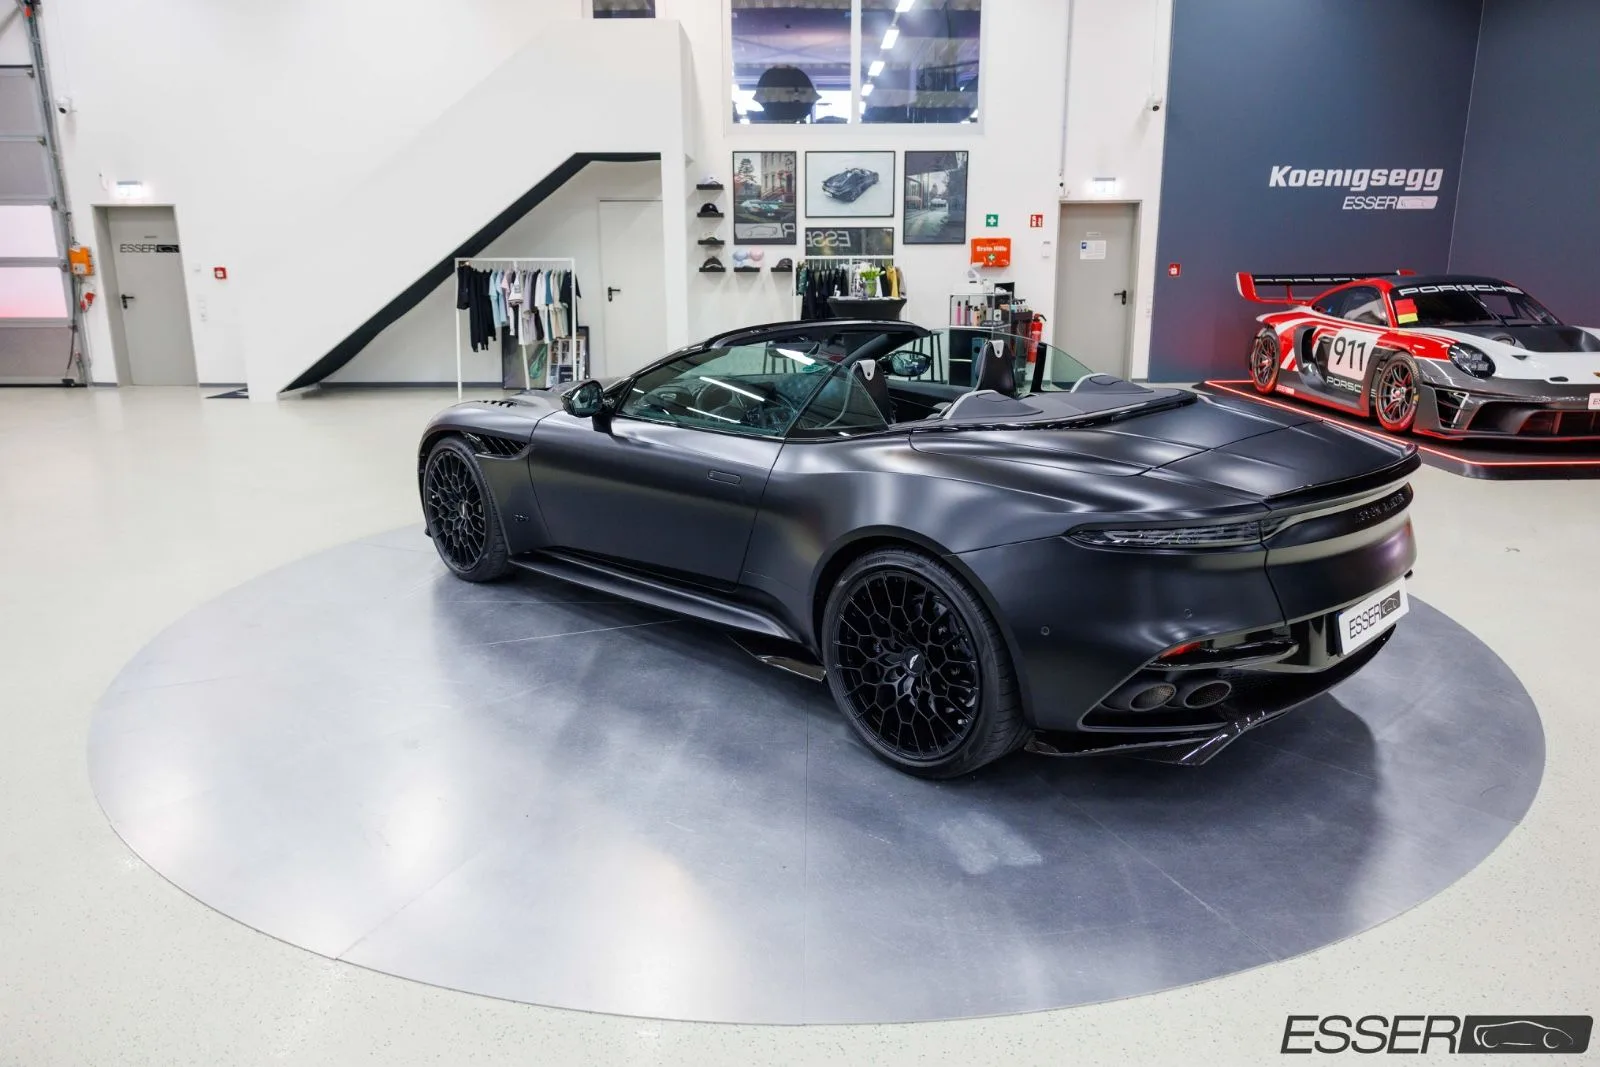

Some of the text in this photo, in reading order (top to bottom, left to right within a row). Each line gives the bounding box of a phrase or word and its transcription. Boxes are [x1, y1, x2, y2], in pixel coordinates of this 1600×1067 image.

[1269, 165, 1444, 191] Koenigsegg
[1342, 196, 1398, 210] ESSER
[120, 244, 156, 253] ESSER
[1398, 284, 1524, 297] PORSCHE
[1334, 336, 1367, 371] 911
[1349, 603, 1381, 640] ESSER
